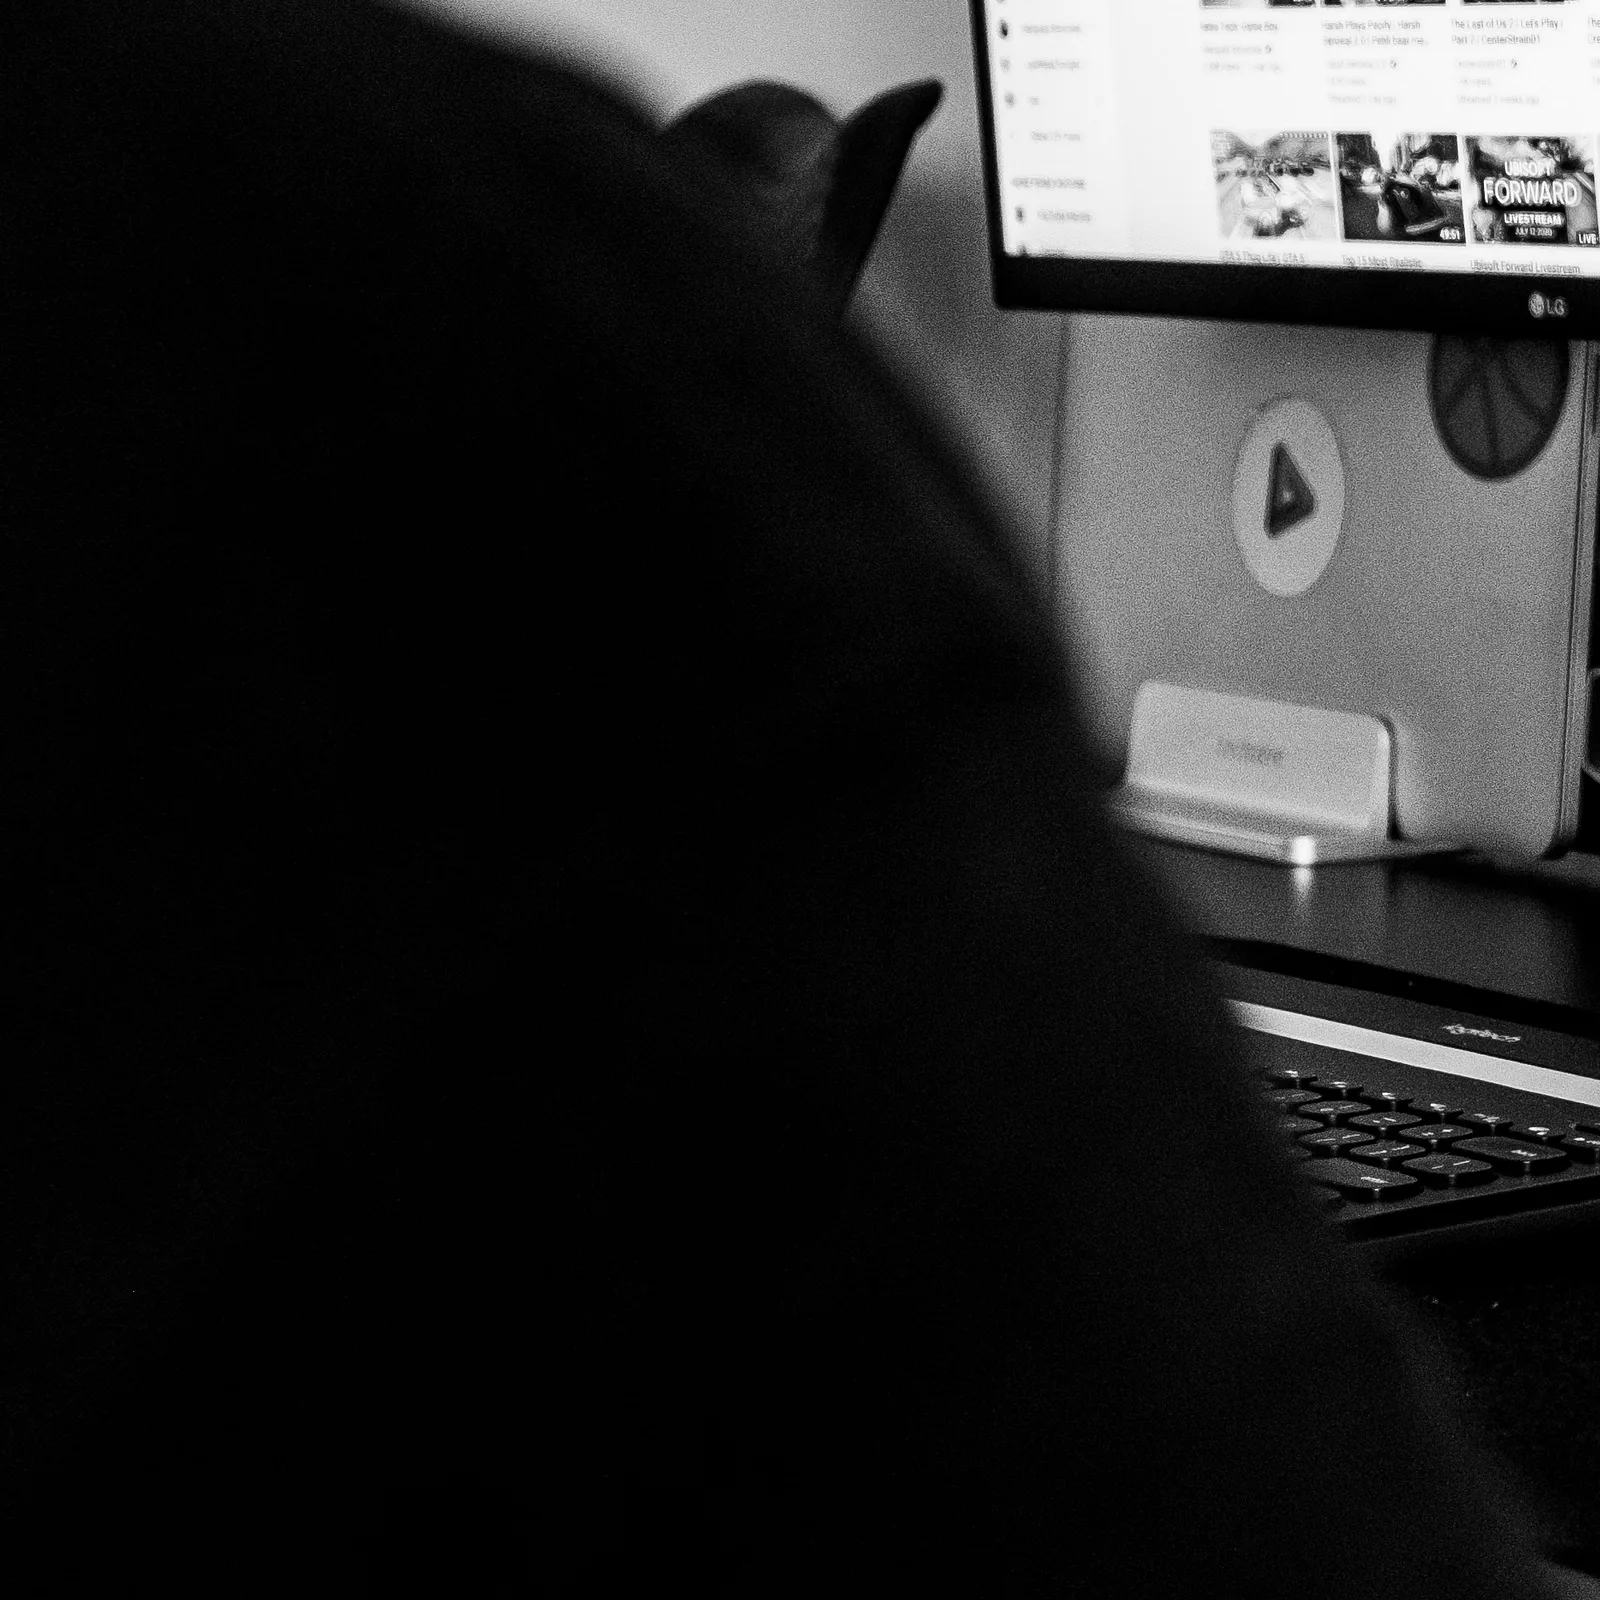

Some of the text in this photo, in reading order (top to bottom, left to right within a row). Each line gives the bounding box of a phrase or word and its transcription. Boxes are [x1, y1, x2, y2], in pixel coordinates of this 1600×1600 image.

[1504, 158, 1553, 177] UBISOFT
[1482, 177, 1579, 207] FORWARD
[1503, 212, 1564, 226] LIVESTREAM
[1578, 233, 1597, 245] LIVE
[1501, 261, 1534, 273] Forward
[1535, 262, 1581, 274] Livestream
